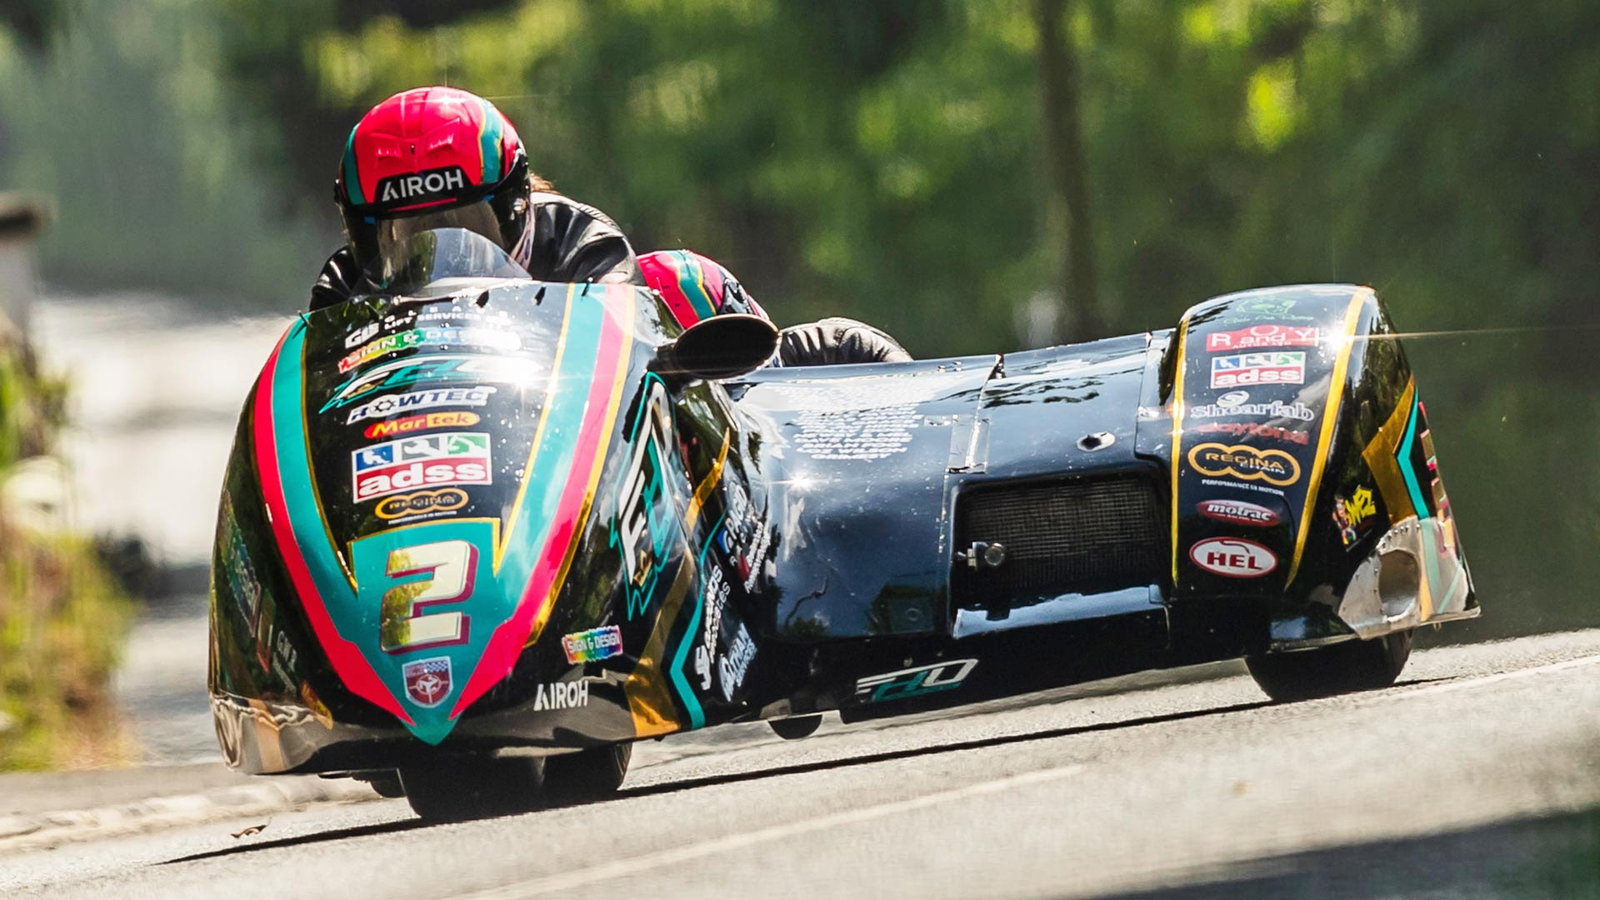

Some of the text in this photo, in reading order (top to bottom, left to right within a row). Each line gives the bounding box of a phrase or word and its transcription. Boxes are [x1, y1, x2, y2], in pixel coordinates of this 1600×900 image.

[382, 168, 464, 202] AIROH
[1215, 369, 1300, 386] adss
[1205, 452, 1283, 469] REGINA
[358, 462, 487, 497] adss
[1202, 479, 1249, 489] PERFORMANCE
[1258, 486, 1284, 496] MOTION
[1208, 504, 1271, 521] motrac
[1207, 551, 1263, 571] HEL
[380, 539, 479, 656] 2
[533, 680, 589, 711] AIROH
